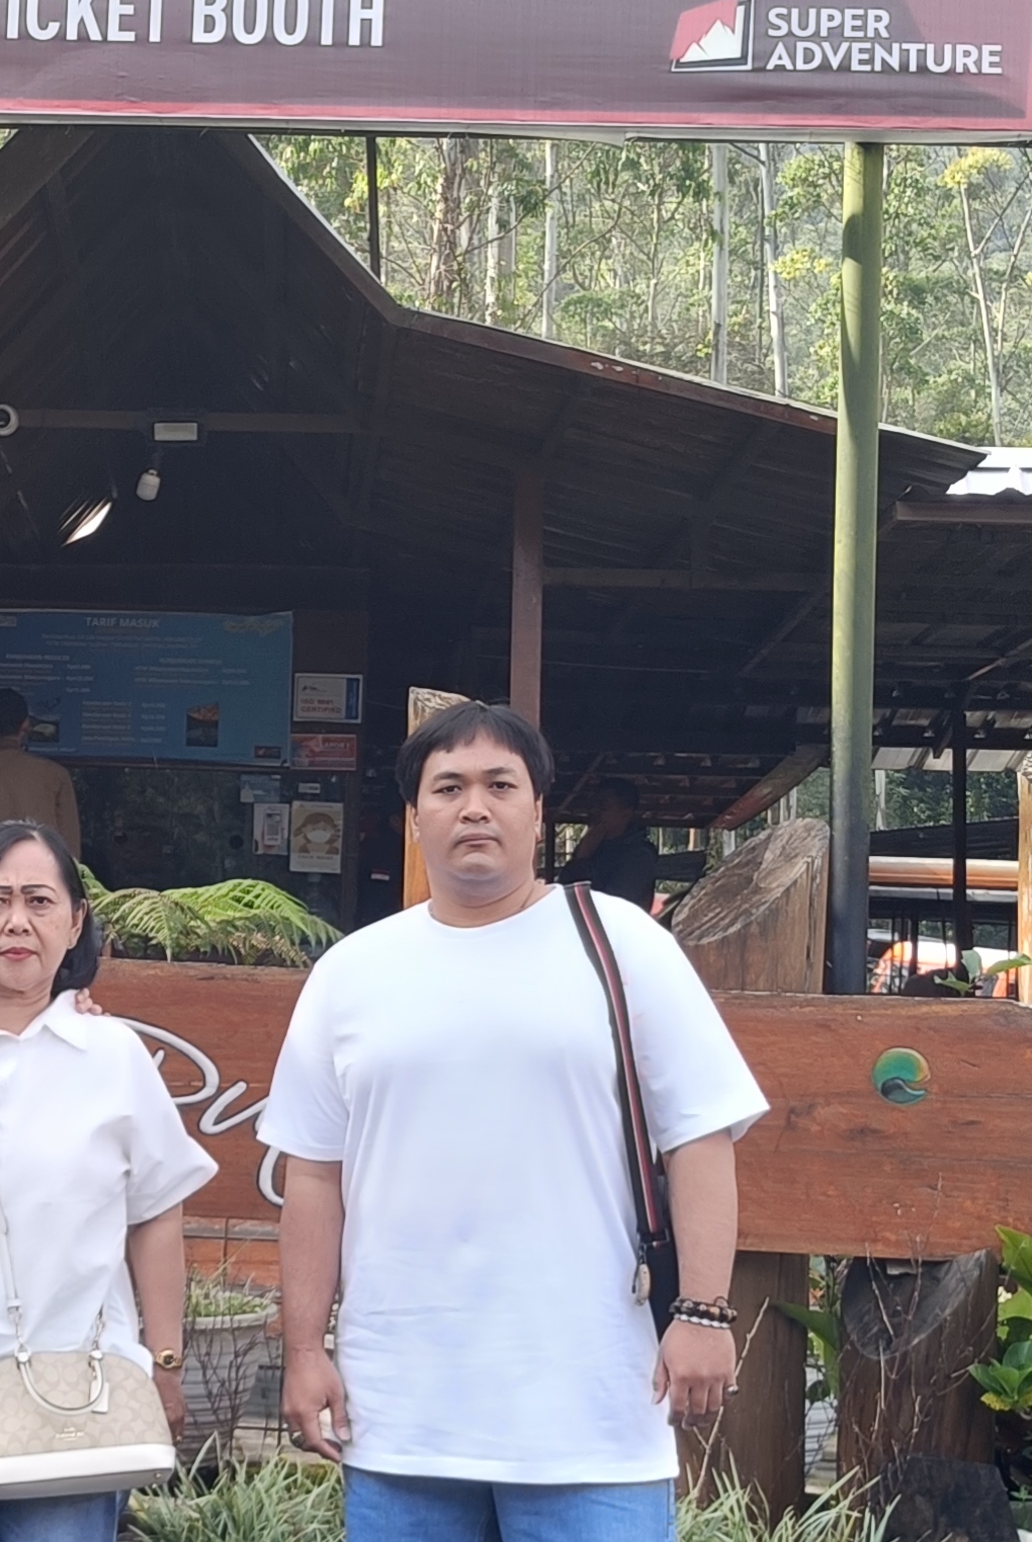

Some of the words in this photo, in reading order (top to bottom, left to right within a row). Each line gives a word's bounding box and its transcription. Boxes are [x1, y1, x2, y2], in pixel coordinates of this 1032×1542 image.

[766, 6, 891, 39] SUPER
[765, 40, 1004, 75] ADVENTURE
[85, 617, 117, 627] TARIF
[119, 618, 160, 628] MASUK
